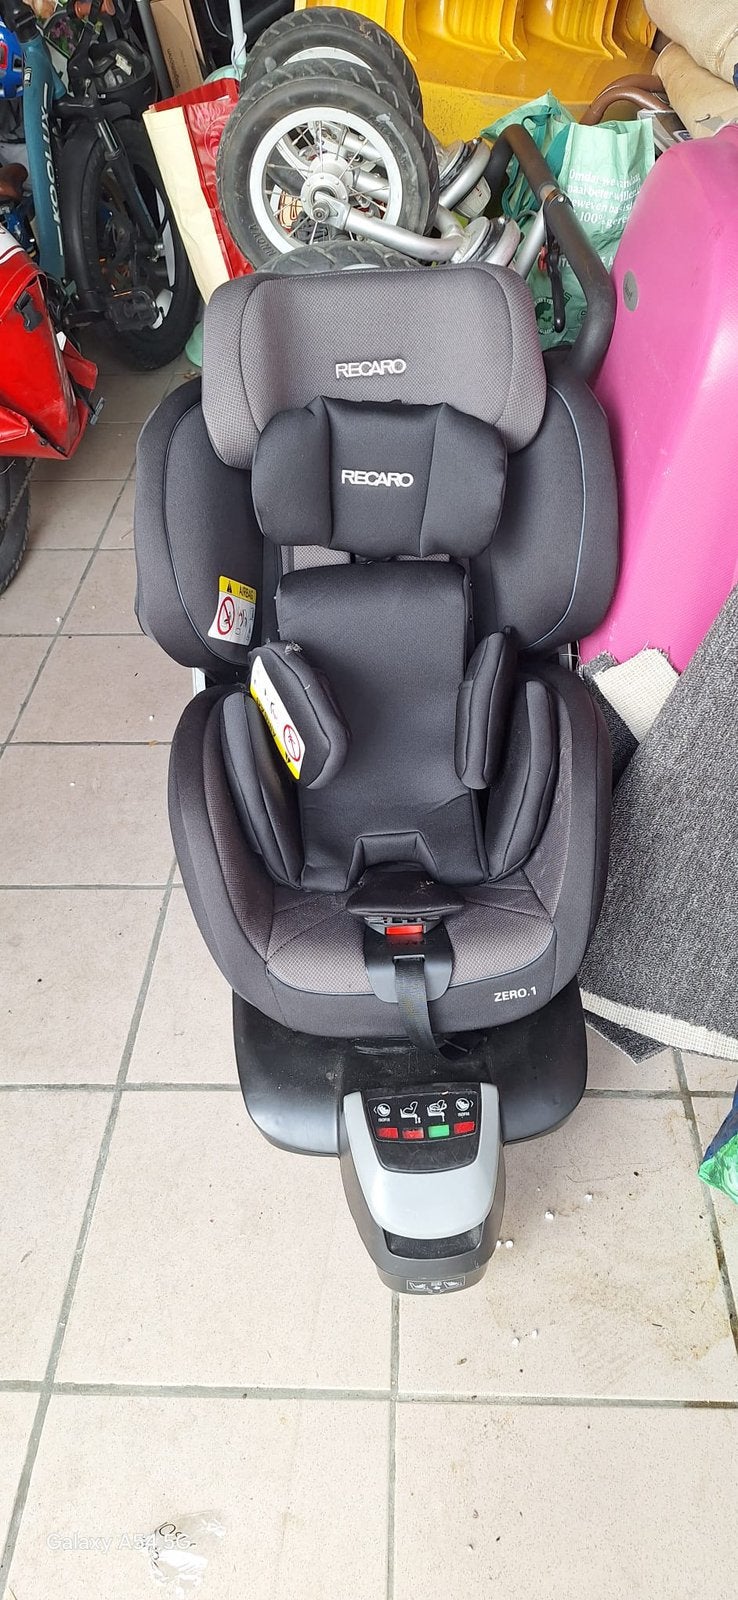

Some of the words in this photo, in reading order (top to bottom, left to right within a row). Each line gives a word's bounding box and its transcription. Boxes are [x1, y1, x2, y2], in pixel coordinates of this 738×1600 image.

[335, 358, 407, 378] RECARO
[341, 469, 414, 487] RECARO
[494, 986, 537, 1002] ZERO.1
